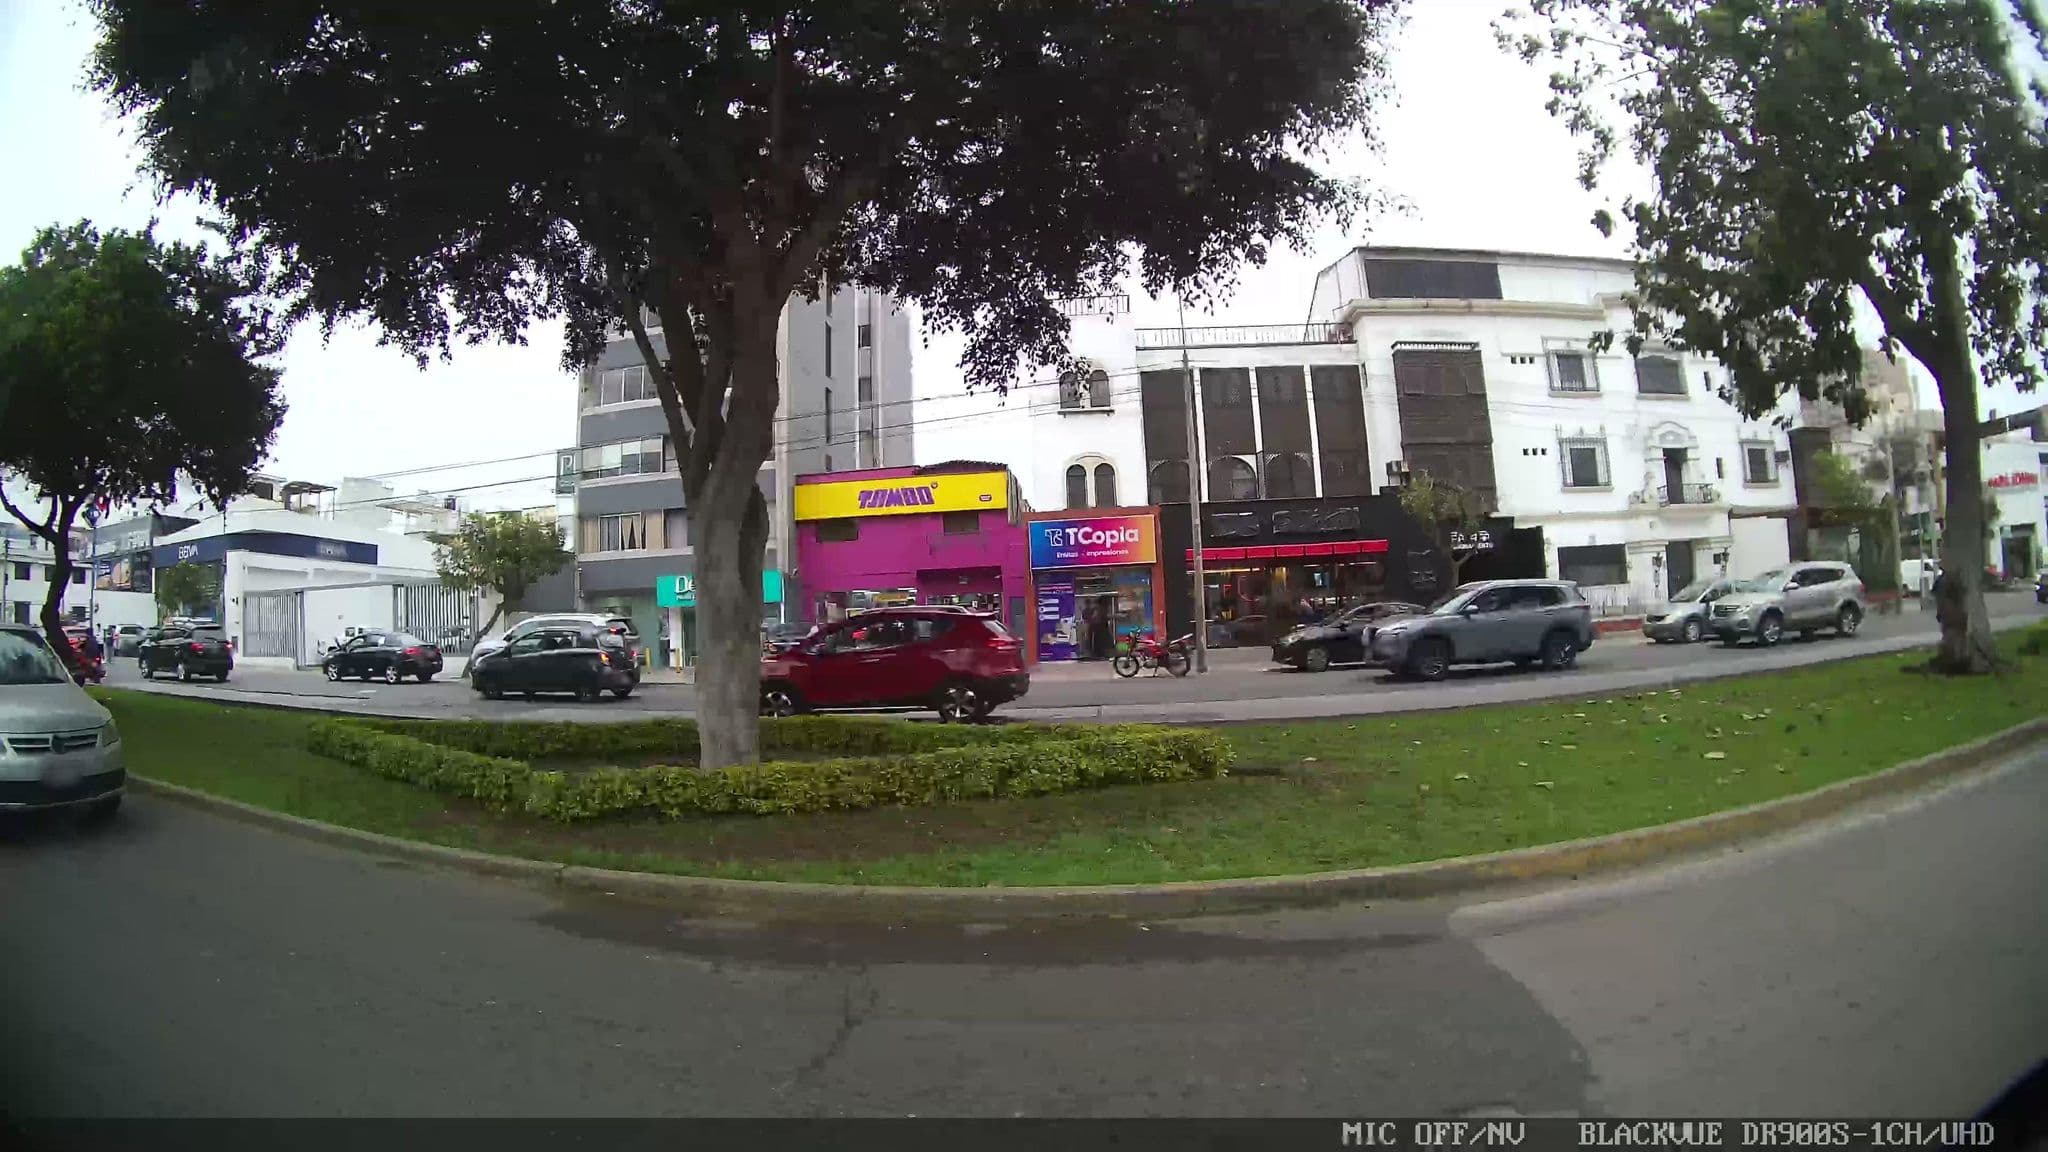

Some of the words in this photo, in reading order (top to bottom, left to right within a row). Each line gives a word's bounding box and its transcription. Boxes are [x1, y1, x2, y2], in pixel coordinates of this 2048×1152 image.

[858, 486, 935, 509] TAMBO
[1065, 526, 1139, 548] TCopia
[178, 544, 199, 560] BBVA
